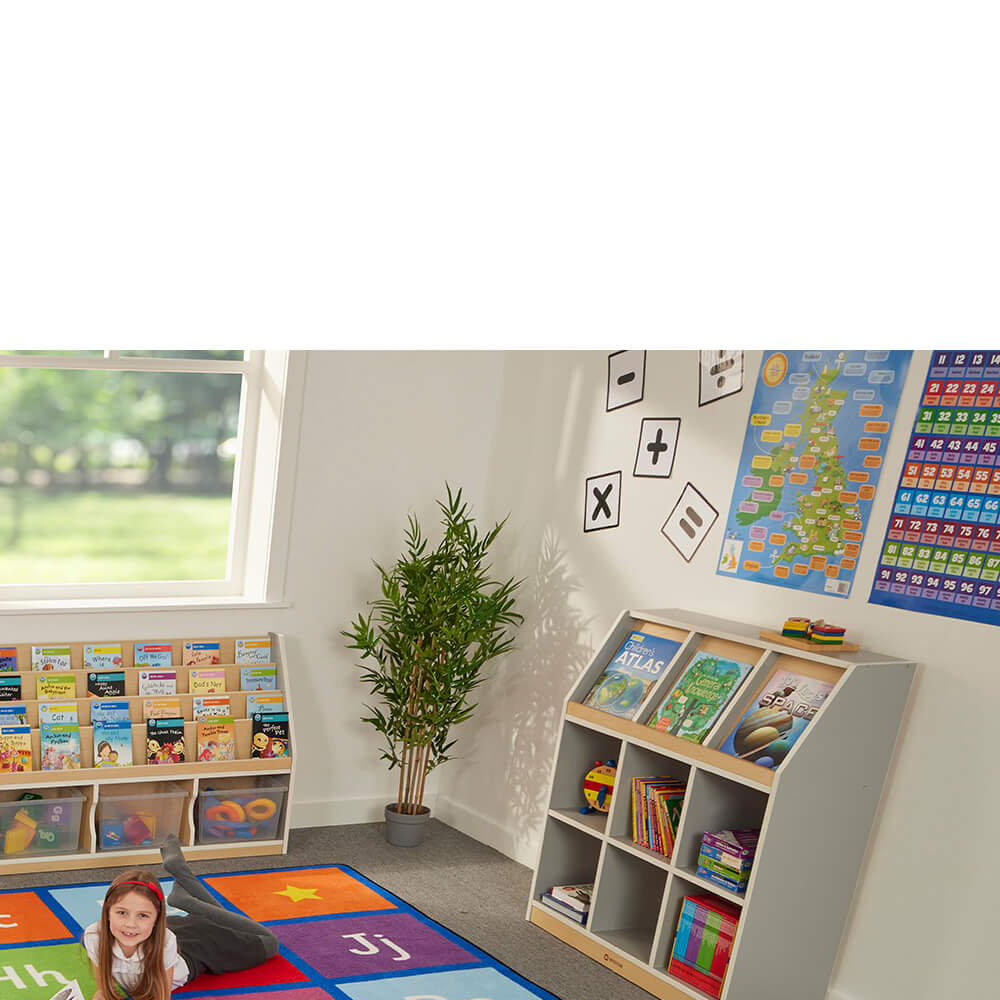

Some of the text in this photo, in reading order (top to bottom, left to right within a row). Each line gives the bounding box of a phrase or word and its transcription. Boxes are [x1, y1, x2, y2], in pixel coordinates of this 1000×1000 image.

[938, 355, 946, 364] 11
[954, 355, 965, 364] 12
[972, 355, 983, 364] 13
[929, 384, 994, 394] 21 22 23 24
[922, 412, 932, 421] 31
[938, 412, 951, 421] 32
[956, 413, 968, 422] 33
[973, 413, 986, 422] 34
[915, 439, 997, 452] 41 42 43 44 45
[908, 466, 918, 475] 51
[923, 467, 936, 476] 52
[941, 468, 953, 477] 53
[957, 469, 971, 479] 54
[975, 471, 988, 480] 55
[901, 492, 999, 510] 61 62 63 64 65 66
[895, 519, 990, 538] 71 72 73 74 75 76
[888, 545, 1000, 568] 81 82 83 84 85 86 87
[881, 570, 992, 595] 91 92 93 94 95 96 97
[615, 651, 665, 674] ATLAS
[759, 693, 820, 721] SPACE
[51, 713, 65, 721] Cat
[341, 932, 411, 961] Jj
